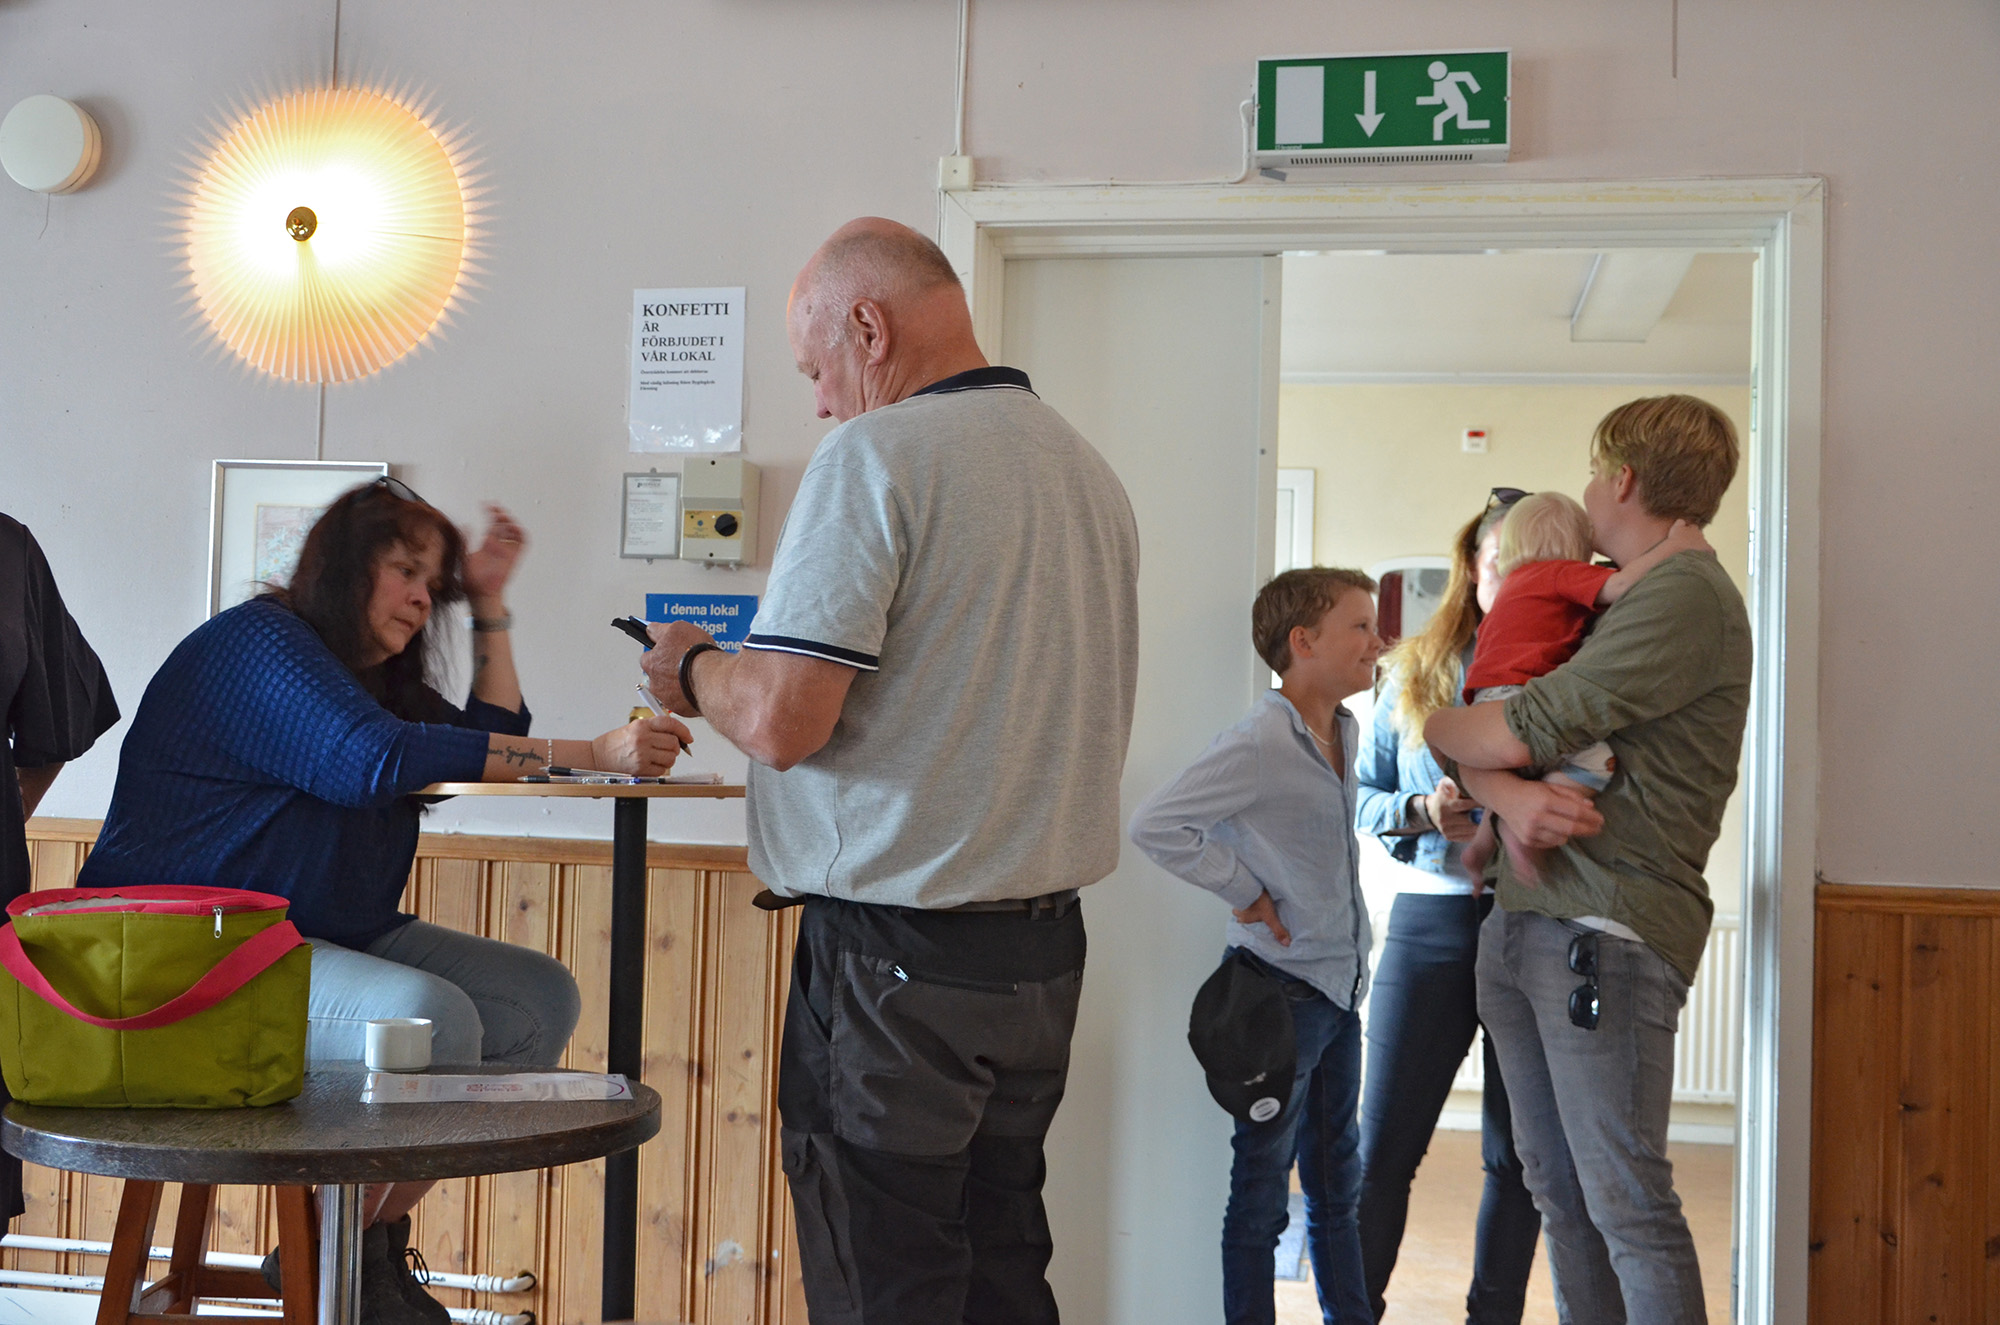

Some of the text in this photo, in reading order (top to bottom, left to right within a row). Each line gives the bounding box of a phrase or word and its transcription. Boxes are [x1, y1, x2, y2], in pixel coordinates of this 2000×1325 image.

[643, 303, 729, 316] KONFETTI
[642, 321, 660, 332] ÄR
[641, 336, 725, 347] FÖRBJUDET I
[641, 351, 716, 362] VÅR LOKAL
[664, 603, 739, 616] I denna lokal
